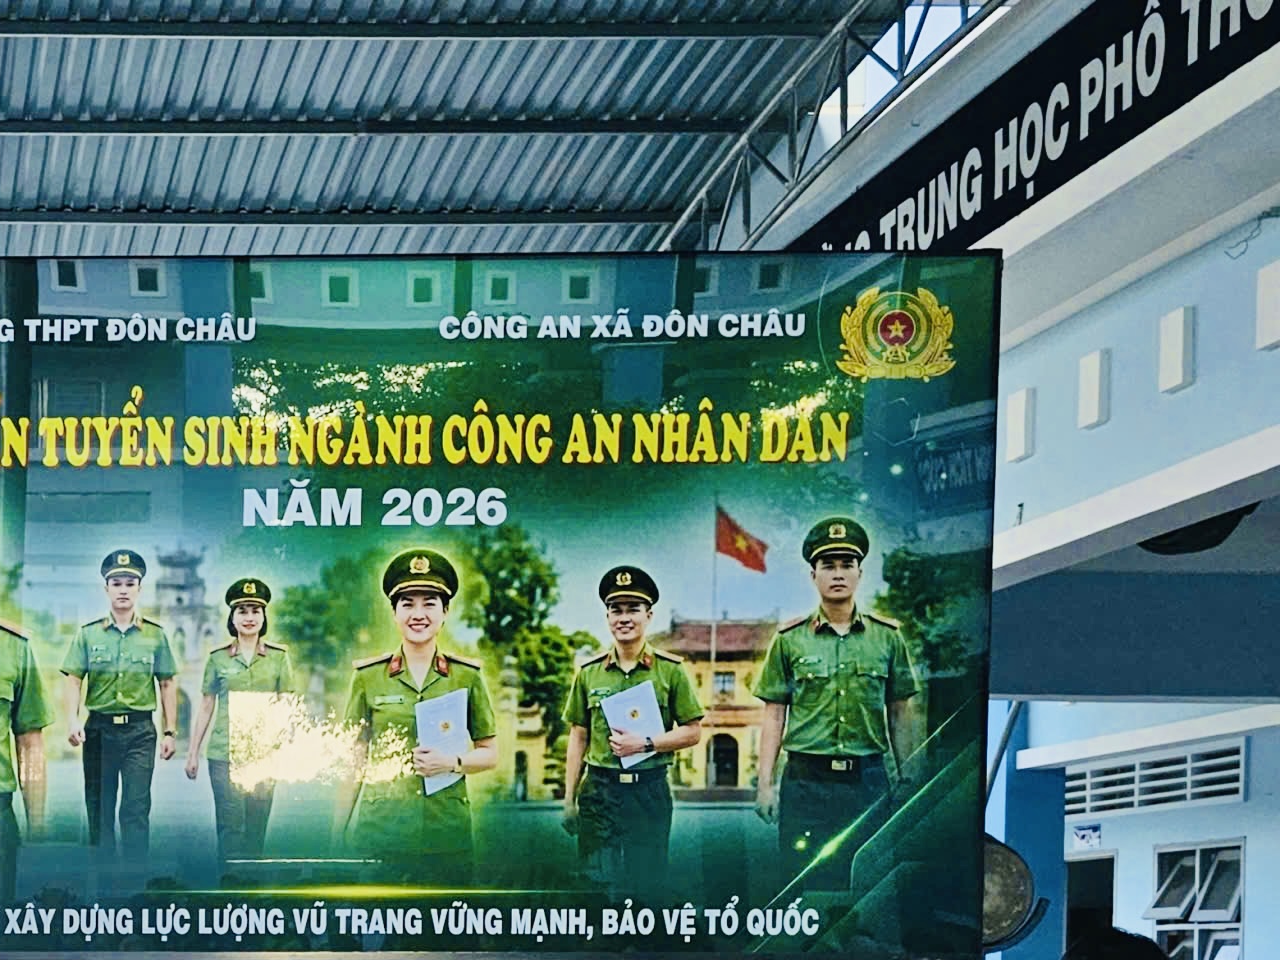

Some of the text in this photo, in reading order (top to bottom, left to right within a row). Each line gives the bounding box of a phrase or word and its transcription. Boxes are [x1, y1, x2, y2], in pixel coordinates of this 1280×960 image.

[879, 147, 983, 251] TRUNG
[993, 81, 1070, 200] HỌC
[1180, 0, 1274, 67] TH
[23, 318, 98, 341] THPT
[106, 313, 167, 341] ĐÔN
[175, 313, 257, 341] CHÂU
[439, 308, 806, 339] CÔNG AN XÃ ĐÔN CHÂU
[39, 385, 174, 467] TUYỂN
[183, 415, 277, 466] SINH
[287, 400, 433, 465] NGÀNH
[442, 399, 554, 464] CÔNG
[562, 413, 623, 463] AN
[632, 398, 751, 463] NHÂN
[242, 478, 508, 527] NĂM 2026
[4, 902, 56, 934] XÂY
[63, 903, 133, 942] DỰNG
[142, 903, 191, 942] LỰC
[198, 903, 285, 942] LƯỢNG
[292, 900, 327, 935] VŨ
[334, 908, 422, 935] TRANG
[431, 901, 503, 935] VỮNG
[510, 908, 594, 943] MẠNH,
[602, 898, 655, 935] BẢO
[662, 903, 696, 943] VỆ
[704, 895, 739, 936] TỔ
[746, 897, 819, 936] QUỐC
